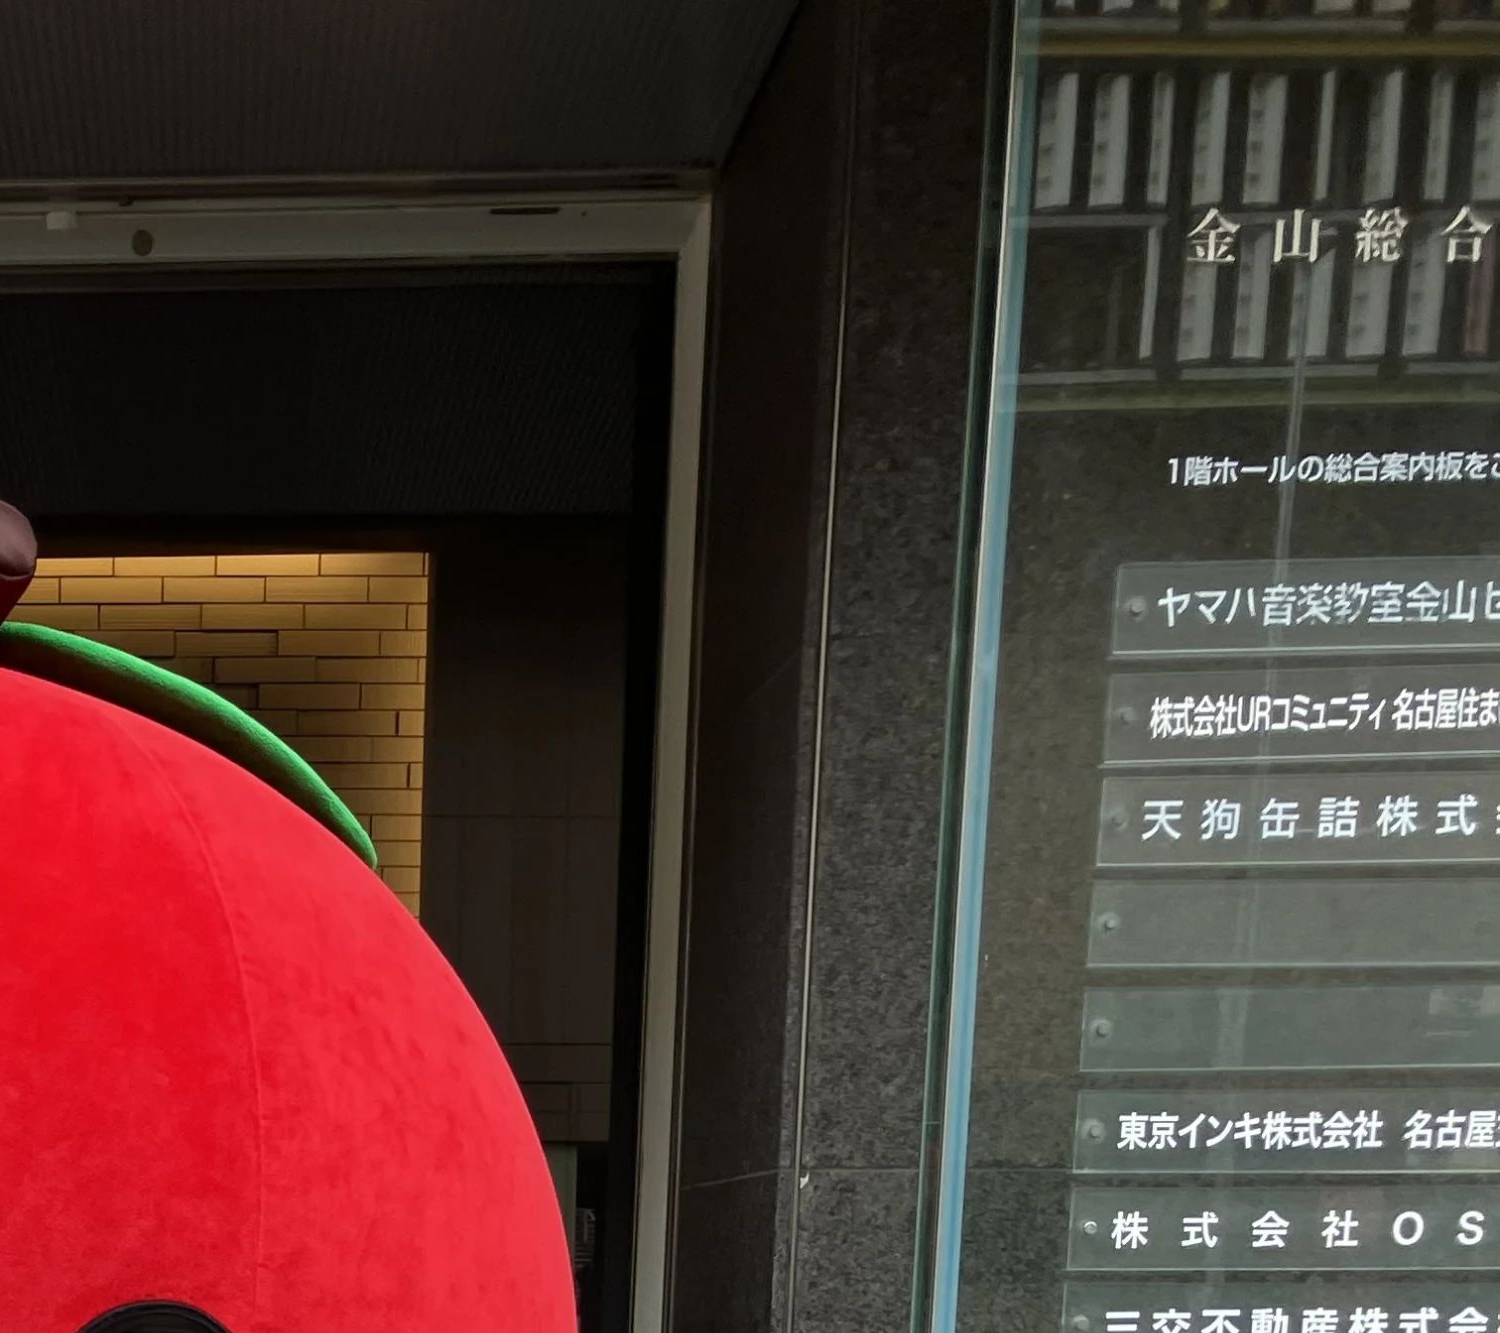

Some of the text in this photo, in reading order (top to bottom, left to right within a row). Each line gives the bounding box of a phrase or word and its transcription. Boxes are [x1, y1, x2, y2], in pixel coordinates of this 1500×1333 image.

[1186, 206, 1493, 264] 金山総合
[1392, 687, 1500, 731] 名古屋住ま
[1141, 794, 1500, 842] 天狗缶詰株式
[1117, 1109, 1500, 1150] 東京インキ株式会社 名古屋
